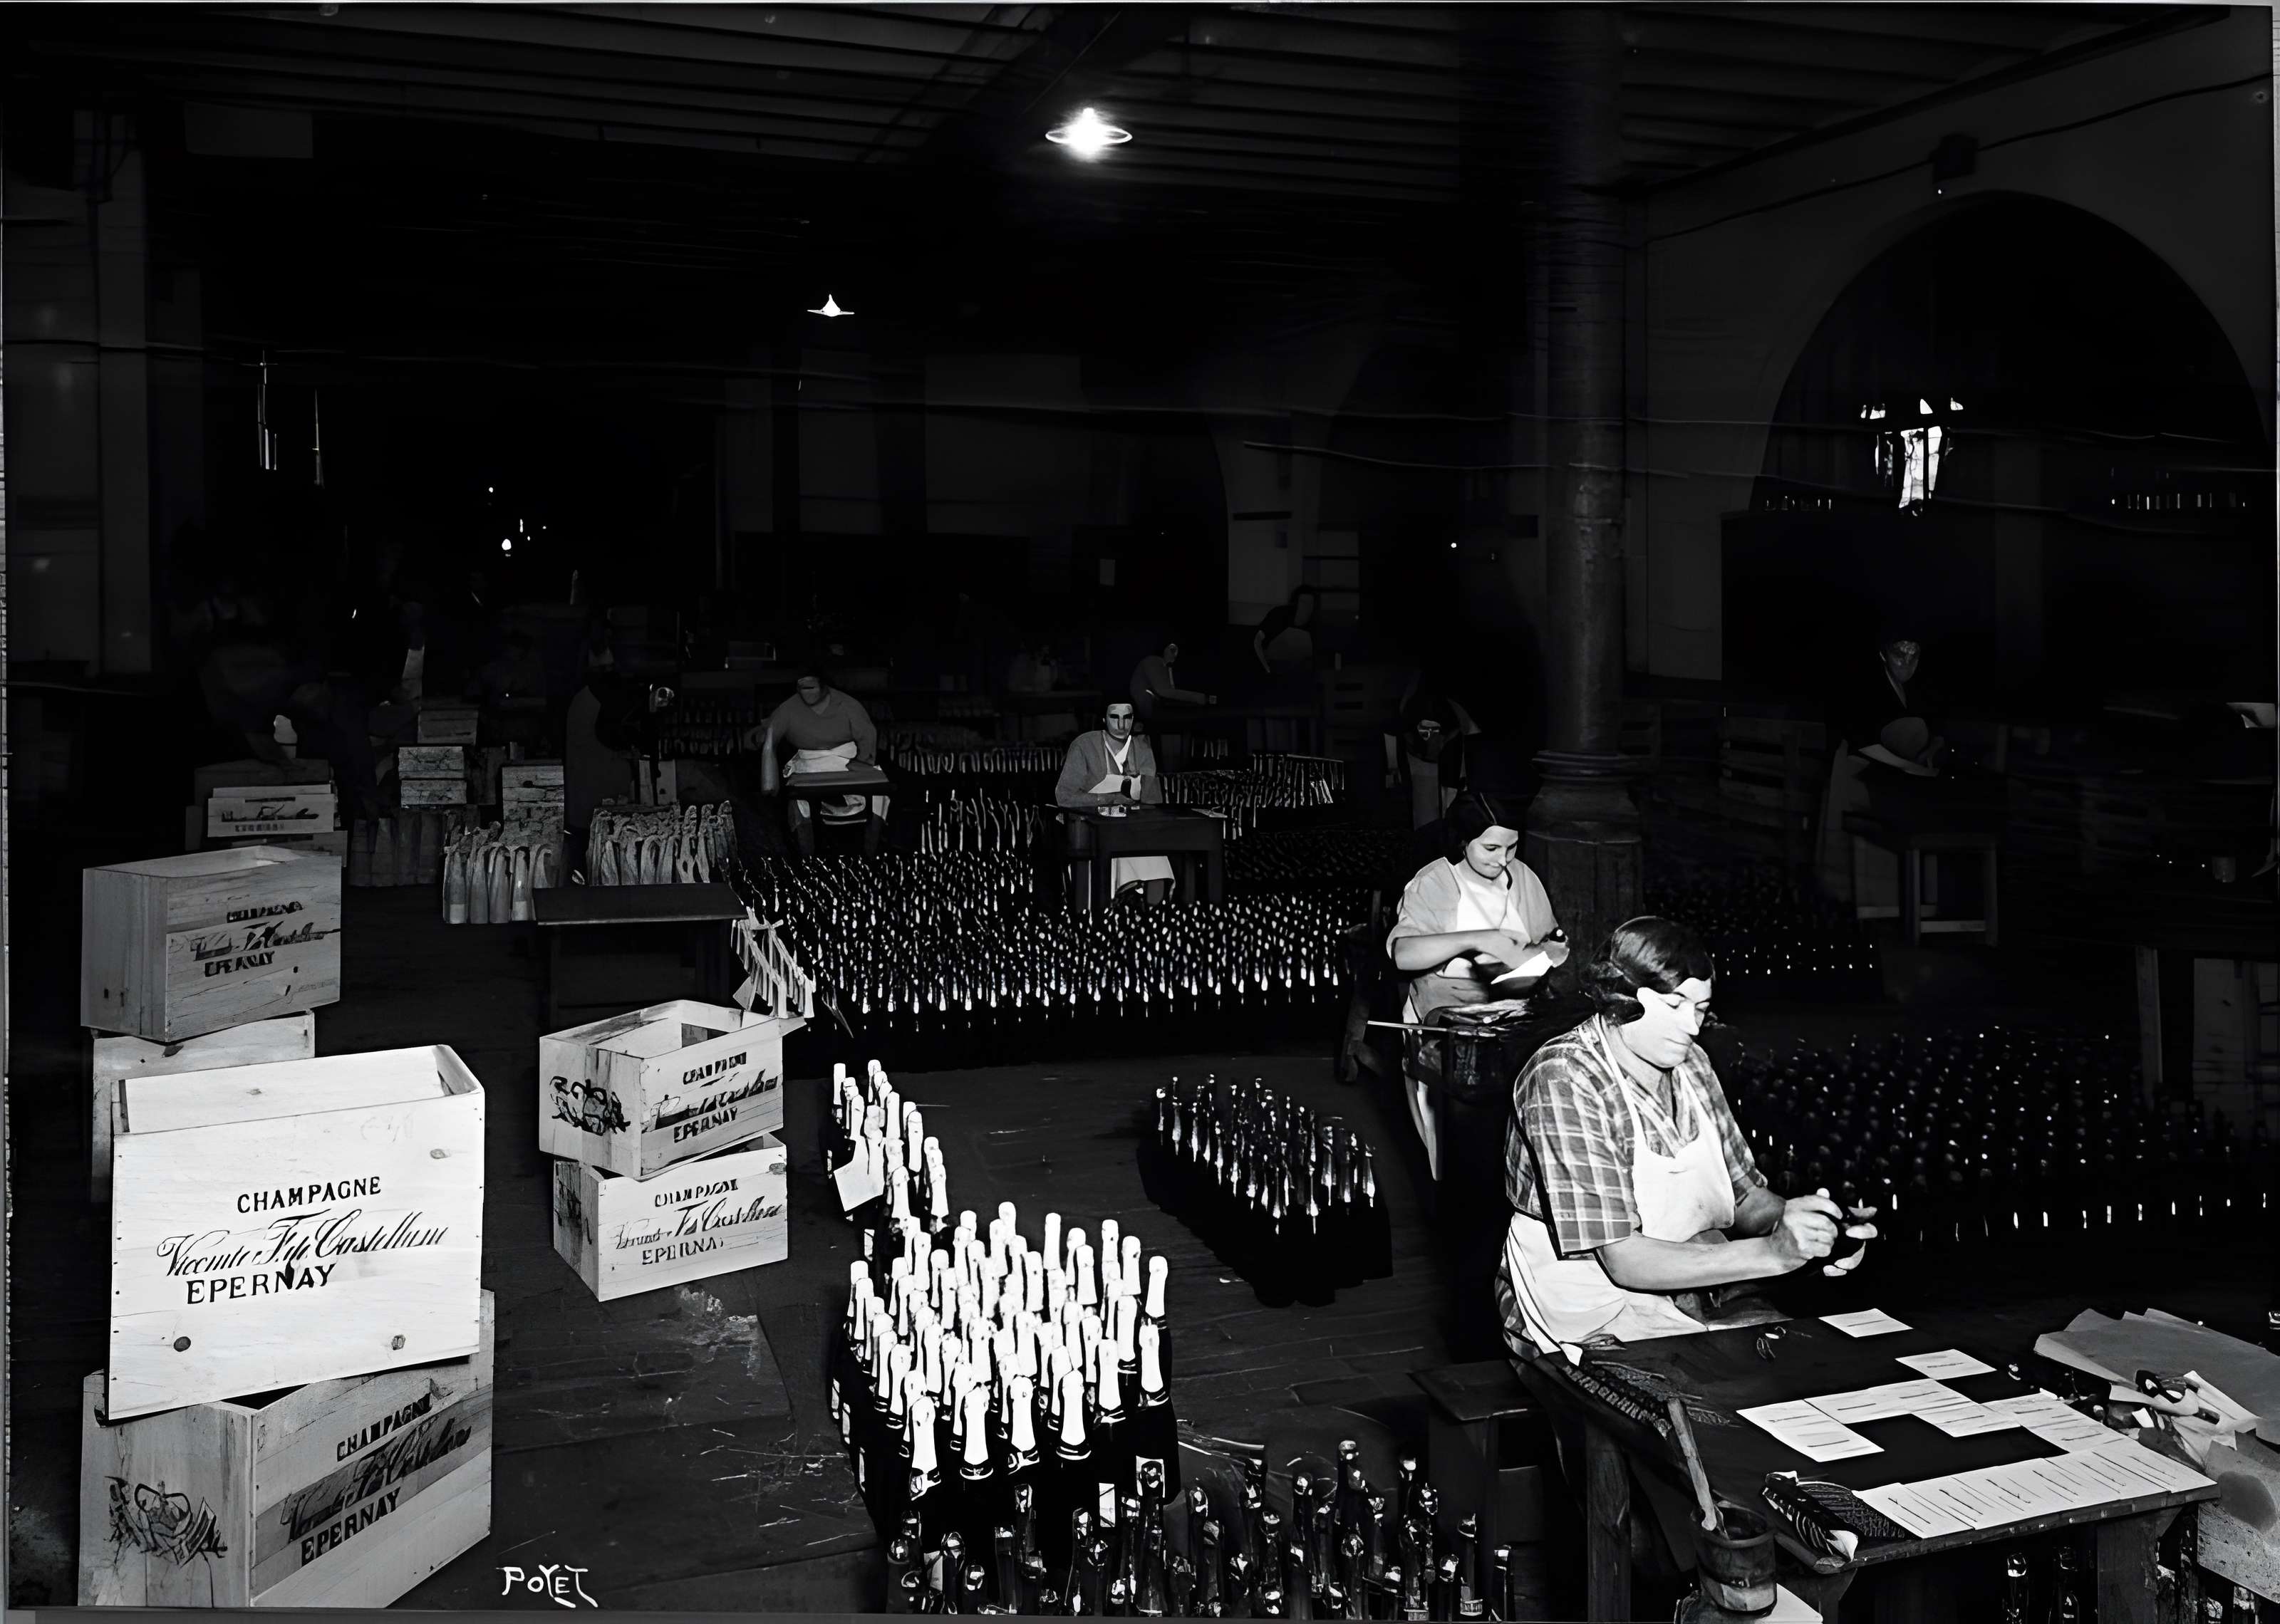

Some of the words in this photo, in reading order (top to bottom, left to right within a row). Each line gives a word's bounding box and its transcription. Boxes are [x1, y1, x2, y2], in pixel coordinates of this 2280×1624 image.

[237, 1175, 381, 1214] CHAMPAGNE
[186, 1263, 337, 1305] EPERNAY
[301, 1487, 402, 1567] EPERNAY
